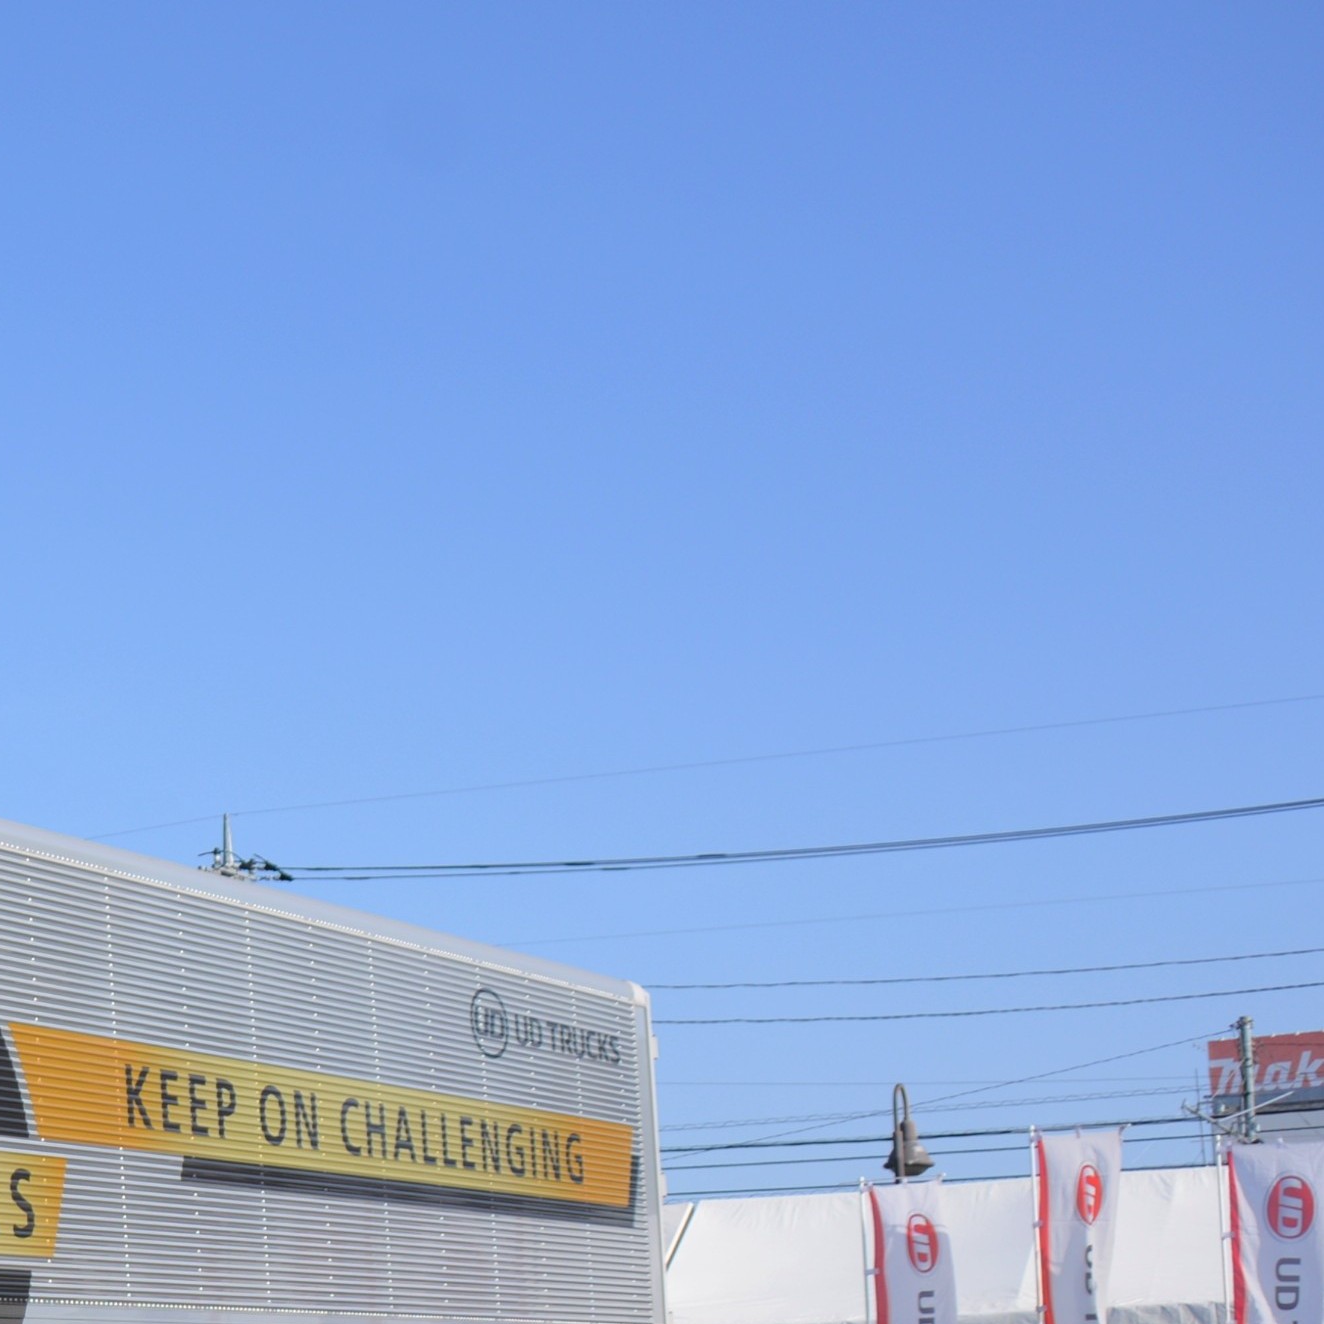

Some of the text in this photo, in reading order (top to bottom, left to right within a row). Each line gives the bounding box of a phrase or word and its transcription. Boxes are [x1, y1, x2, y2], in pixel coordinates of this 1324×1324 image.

[515, 1013, 622, 1065] UD TRUCKS
[124, 1063, 585, 1185] KEEP ON CHALLENGING
[1275, 1256, 1302, 1311] UD
